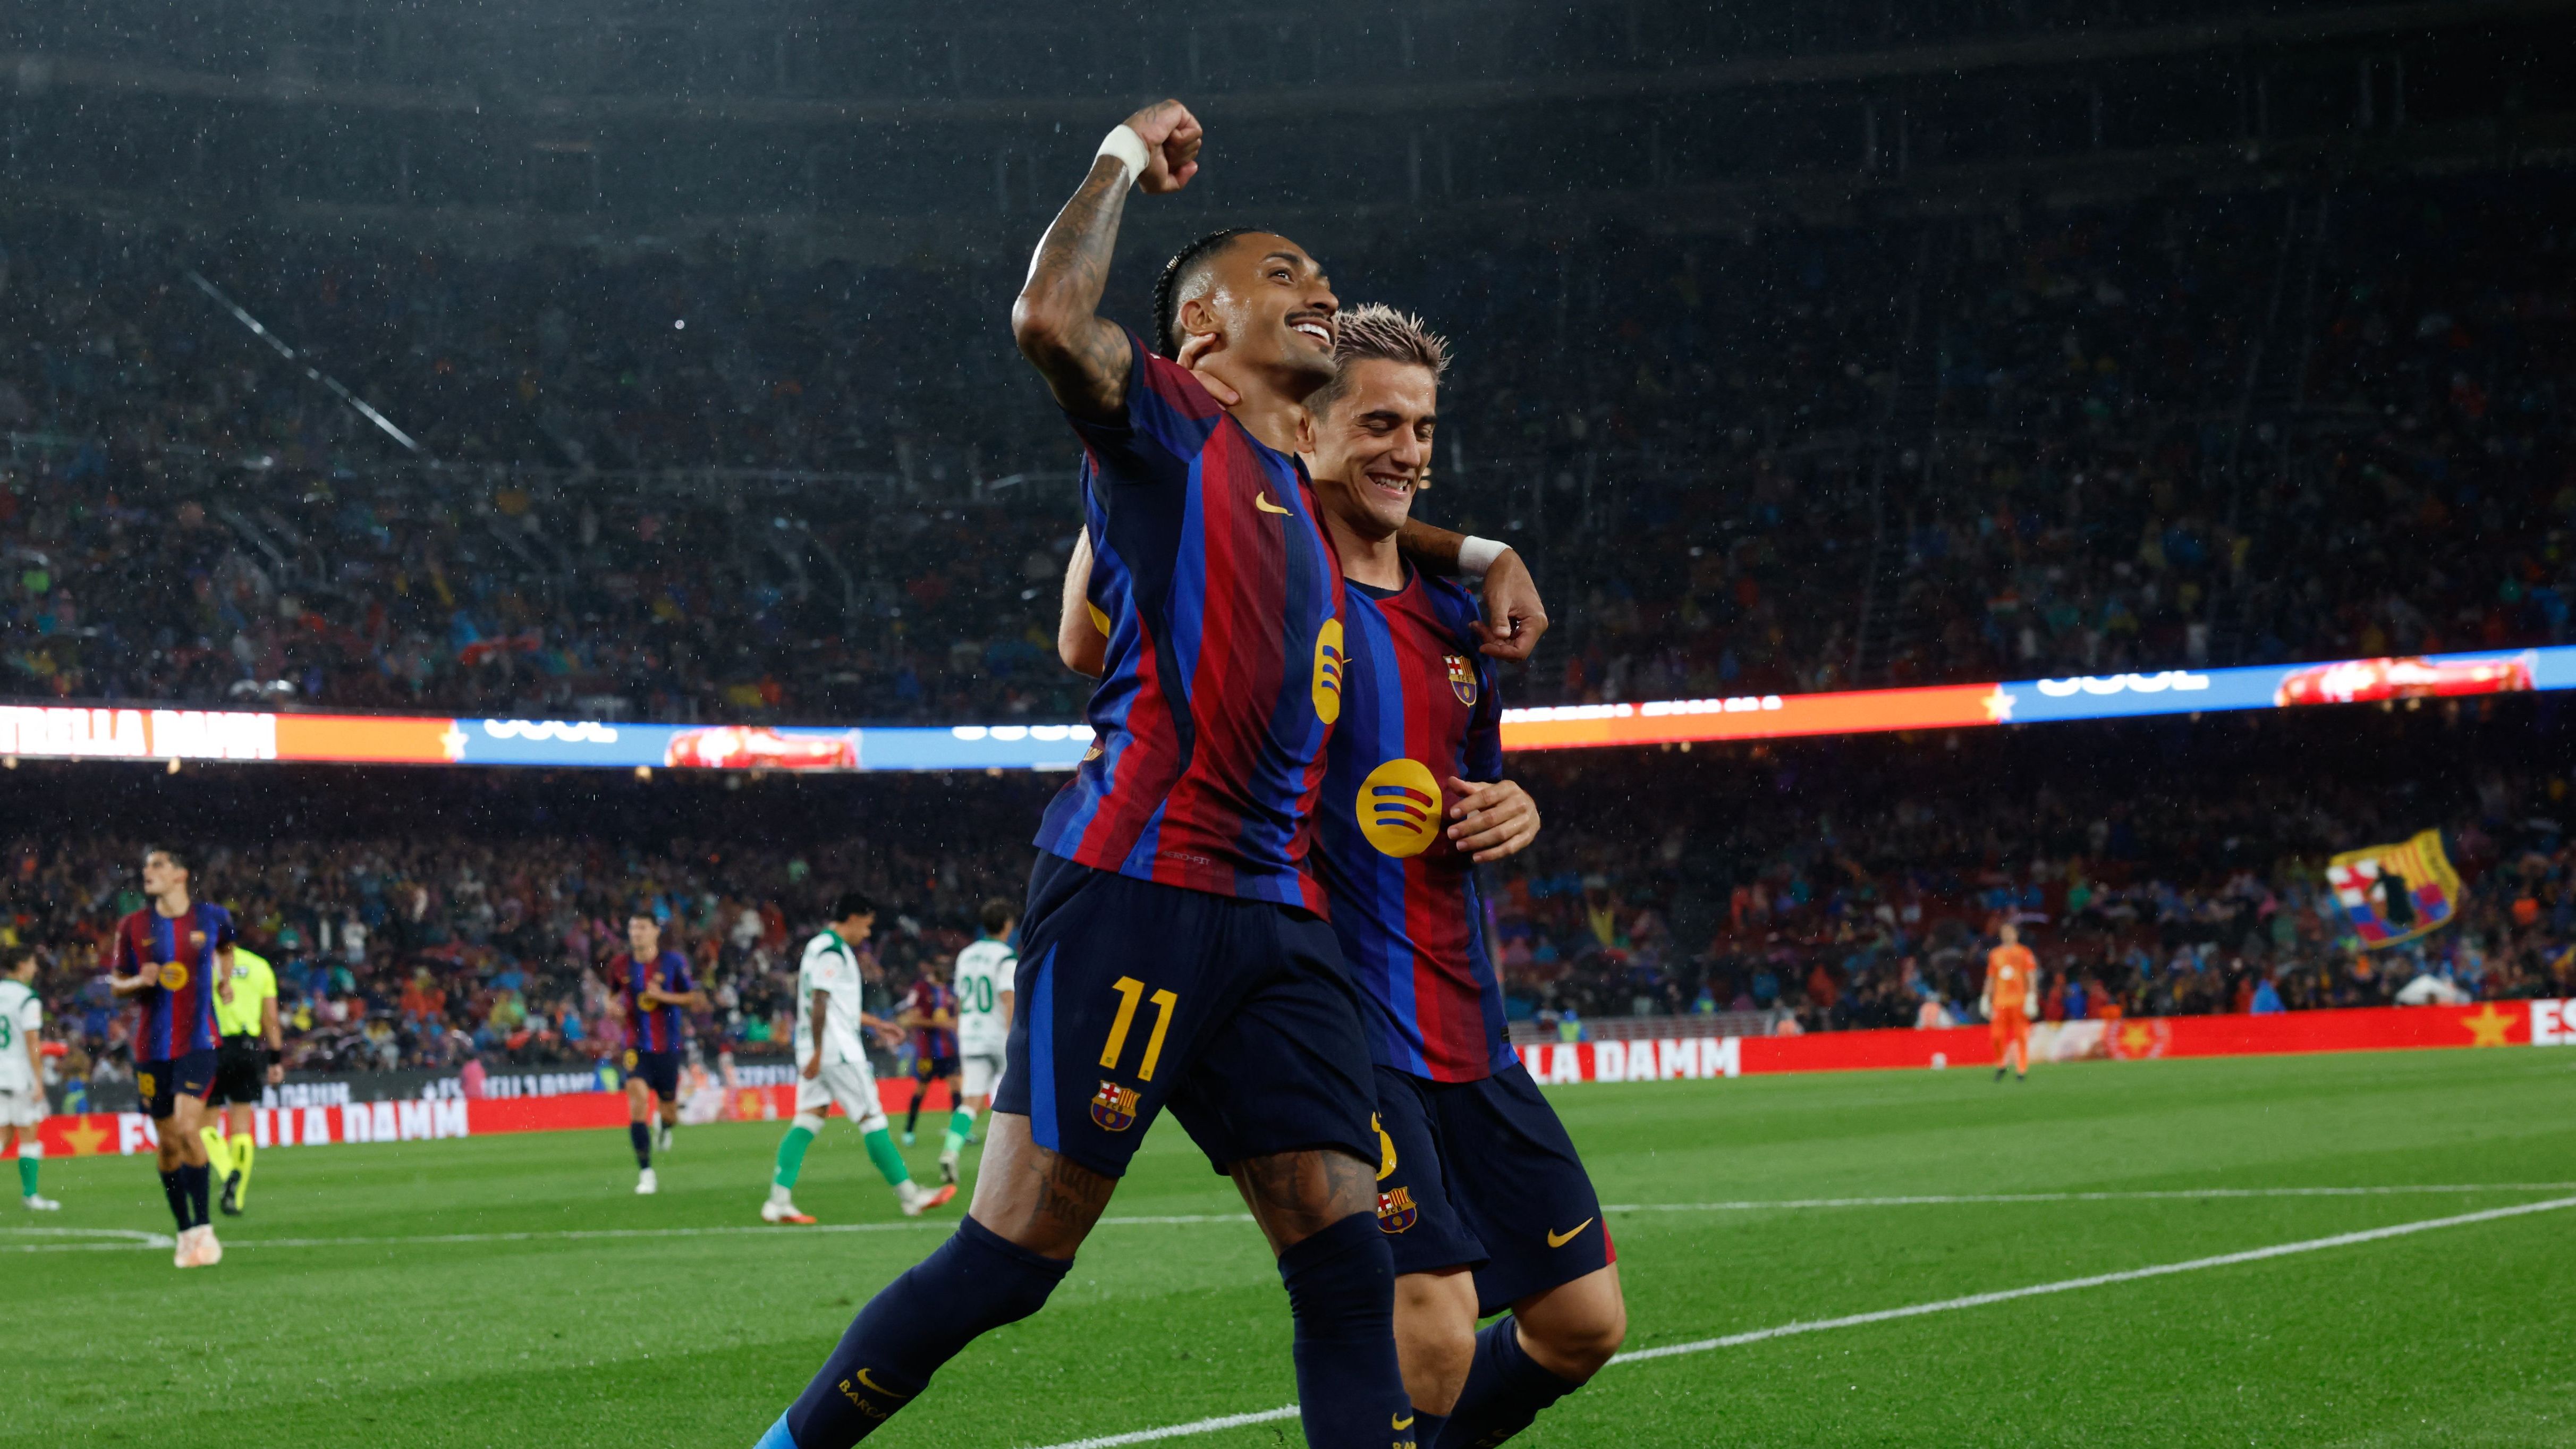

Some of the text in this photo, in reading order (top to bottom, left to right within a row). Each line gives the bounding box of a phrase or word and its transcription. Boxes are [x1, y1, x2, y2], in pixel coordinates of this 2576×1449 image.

[960, 976, 993, 1014] 20
[1099, 976, 1177, 1082] 11
[1595, 1036, 1740, 1083] DAMM
[343, 1098, 468, 1143] DAMM
